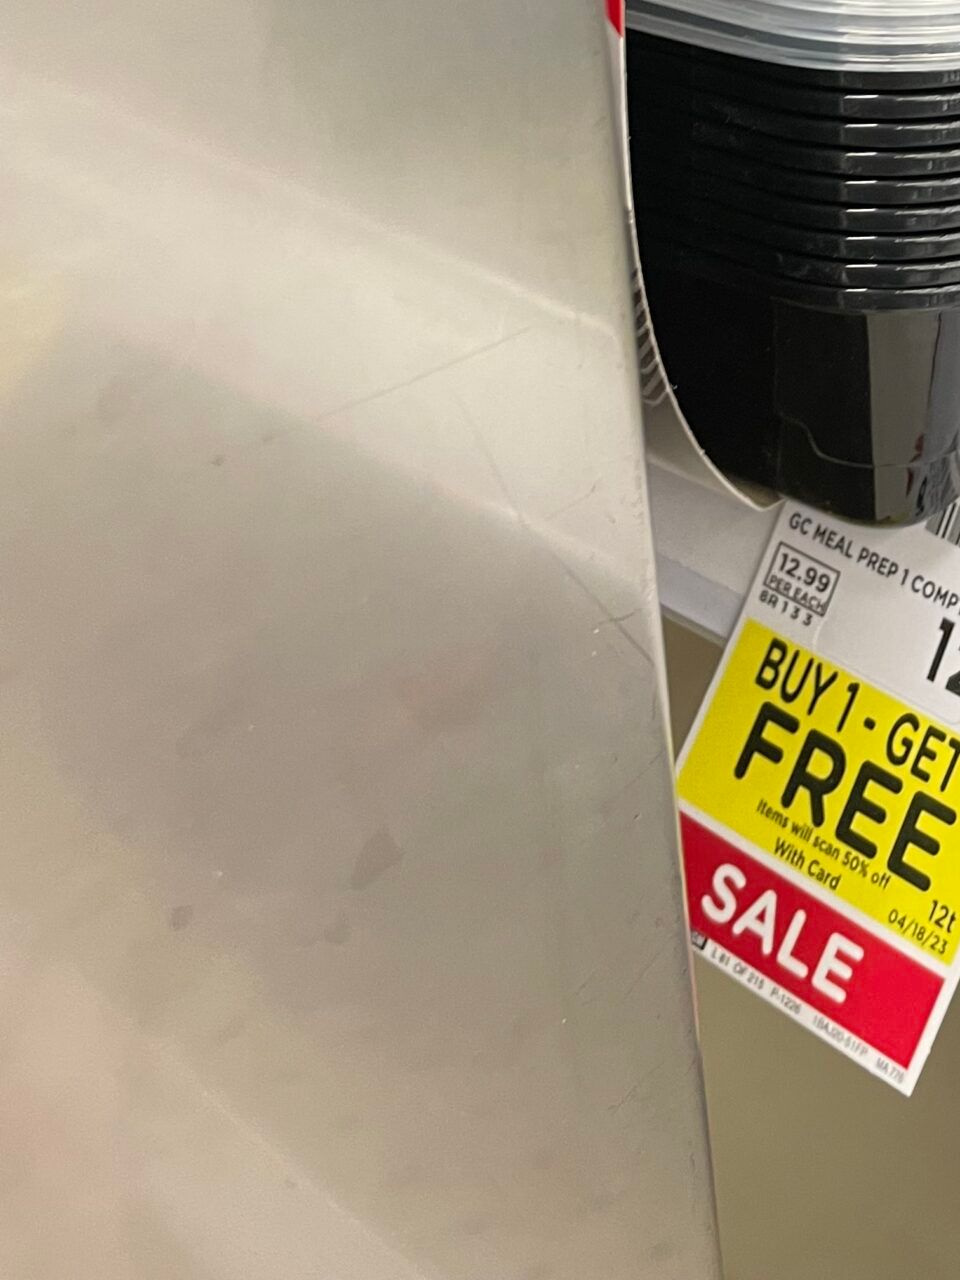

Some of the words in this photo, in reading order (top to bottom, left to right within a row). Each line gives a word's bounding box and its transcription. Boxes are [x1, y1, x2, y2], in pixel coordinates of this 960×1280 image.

[779, 553, 830, 593] 12.99
[788, 513, 813, 535] GC
[812, 523, 853, 559] MEAL
[856, 547, 898, 578] PREP
[900, 569, 910, 586] 1
[769, 575, 792, 595] PER
[794, 588, 827, 612] EACH
[755, 637, 840, 716] BUY
[836, 682, 861, 734] 1
[733, 701, 957, 892] FREE
[756, 799, 788, 829] Items
[792, 822, 813, 842] will
[812, 839, 841, 860] scan
[842, 852, 870, 878] 50%
[871, 871, 892, 890] off
[774, 836, 805, 869] With
[807, 859, 841, 891] Card
[701, 861, 865, 1004] SALE
[888, 908, 950, 955] 04/18/23
[928, 899, 956, 934] 12t
